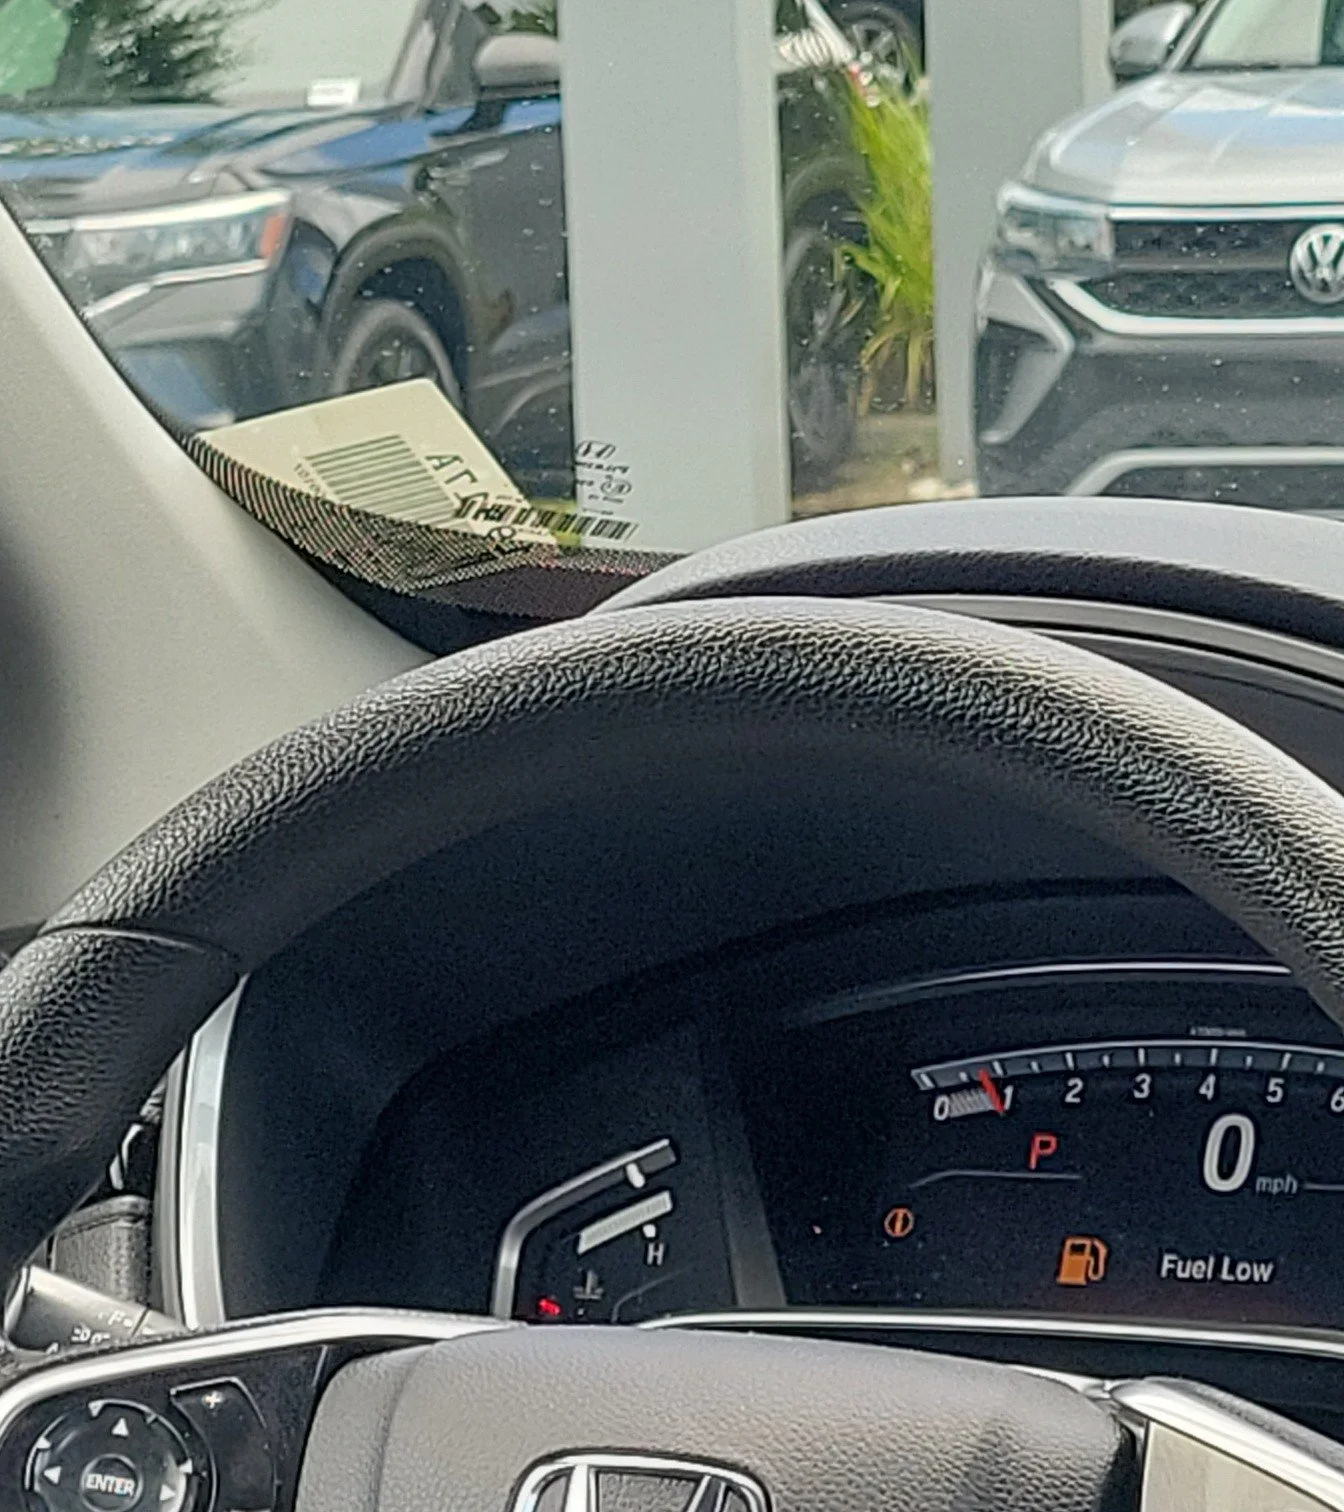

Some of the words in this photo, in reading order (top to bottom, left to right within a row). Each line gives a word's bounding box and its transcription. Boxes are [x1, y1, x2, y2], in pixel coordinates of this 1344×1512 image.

[932, 1095, 949, 1120] 0
[1065, 1078, 1083, 1103] 2
[1133, 1074, 1152, 1099] 3
[1199, 1074, 1216, 1100] 4
[1266, 1078, 1284, 1103] 5
[1030, 1133, 1057, 1169] P
[1202, 1114, 1256, 1192] 0
[1255, 1174, 1298, 1196] mph
[646, 1243, 666, 1265] H
[1161, 1255, 1216, 1281] Fuel
[1221, 1256, 1273, 1283] Low
[86, 1473, 136, 1497] ENTER
